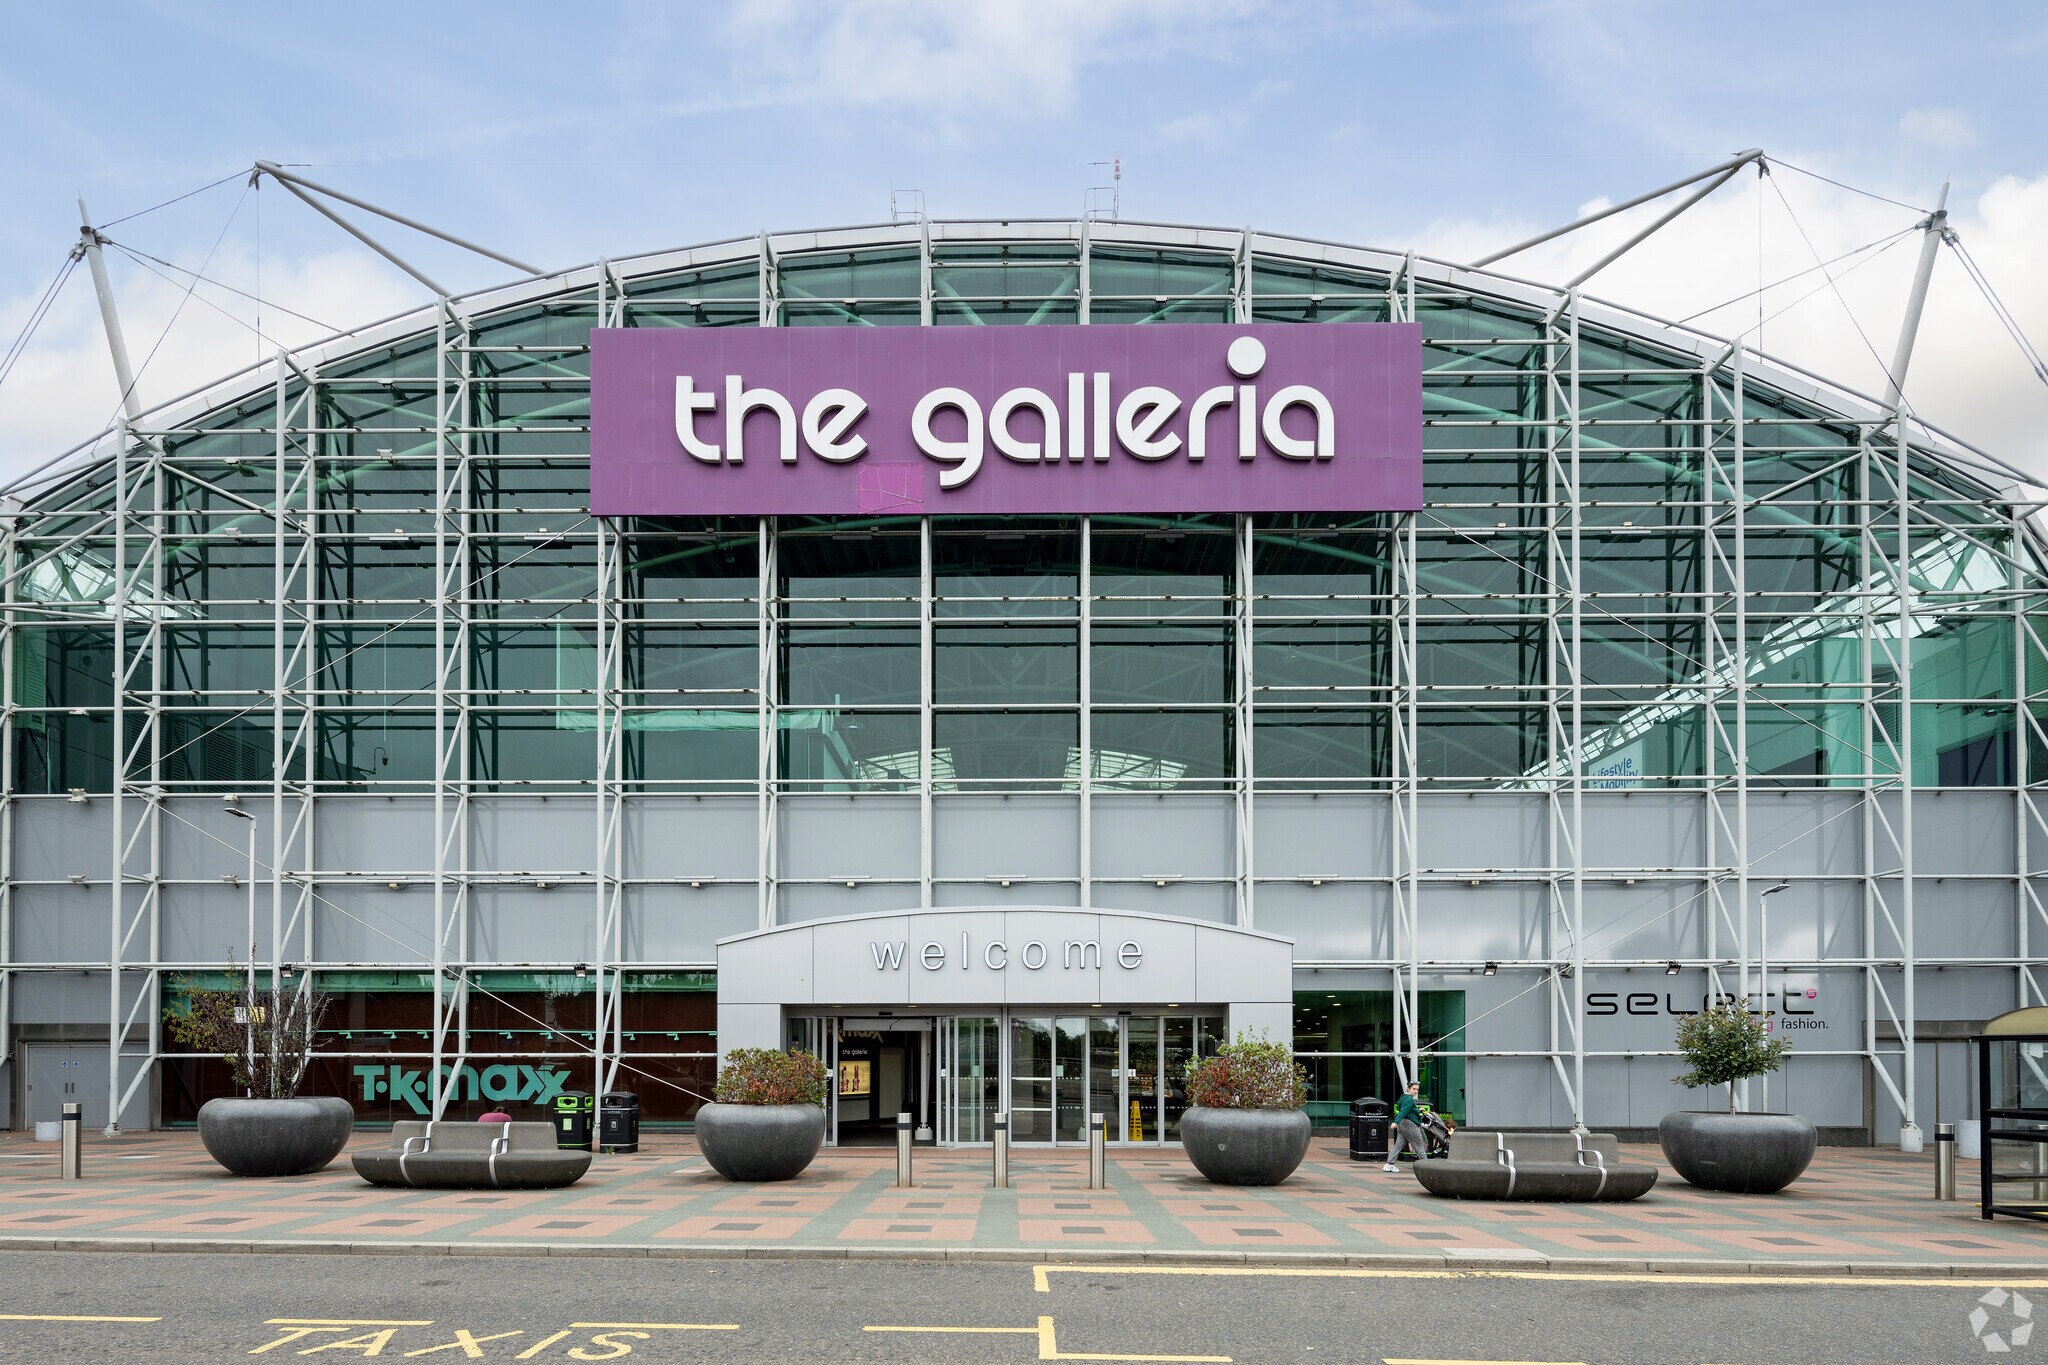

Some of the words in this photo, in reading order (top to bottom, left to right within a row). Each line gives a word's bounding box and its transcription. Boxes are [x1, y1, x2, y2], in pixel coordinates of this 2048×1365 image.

[674, 374, 869, 464] the
[910, 335, 1335, 490] galleria
[869, 931, 1144, 971] welcome
[1781, 1017, 1829, 1030] fashion.
[247, 1327, 651, 1361] TAXIS
